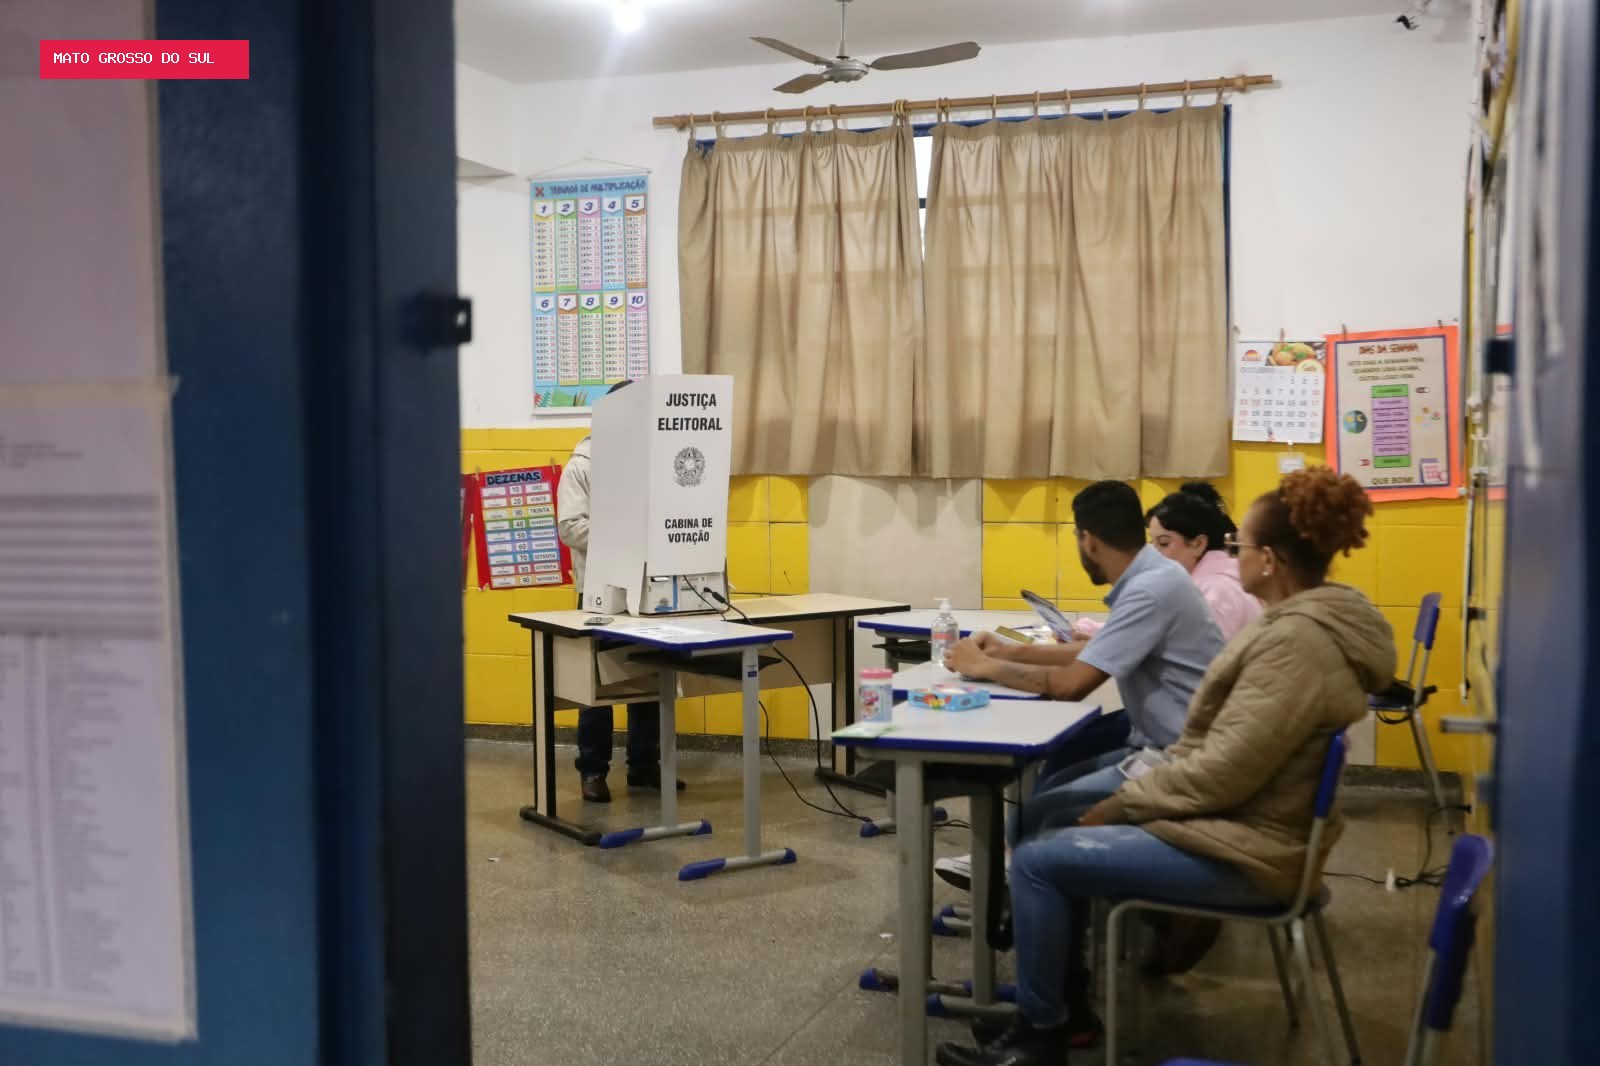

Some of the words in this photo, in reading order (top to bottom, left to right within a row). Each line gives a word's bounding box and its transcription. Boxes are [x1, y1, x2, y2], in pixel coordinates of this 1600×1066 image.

[540, 205, 547, 214] 1
[561, 203, 570, 212] 2
[584, 202, 593, 211] 3
[608, 200, 616, 209] 4
[631, 199, 640, 208] 5
[541, 299, 549, 308] 6
[563, 298, 571, 307] 7
[586, 297, 594, 306] 8
[609, 296, 618, 305] 9
[631, 295, 643, 305] 10
[665, 393, 717, 410] JUSTIÇA
[657, 417, 723, 431] ELEITORAL
[486, 471, 541, 485] DEZENAS
[664, 518, 699, 529] CABINA
[701, 517, 713, 528] DE
[667, 530, 710, 545] VOTAÇÃO
